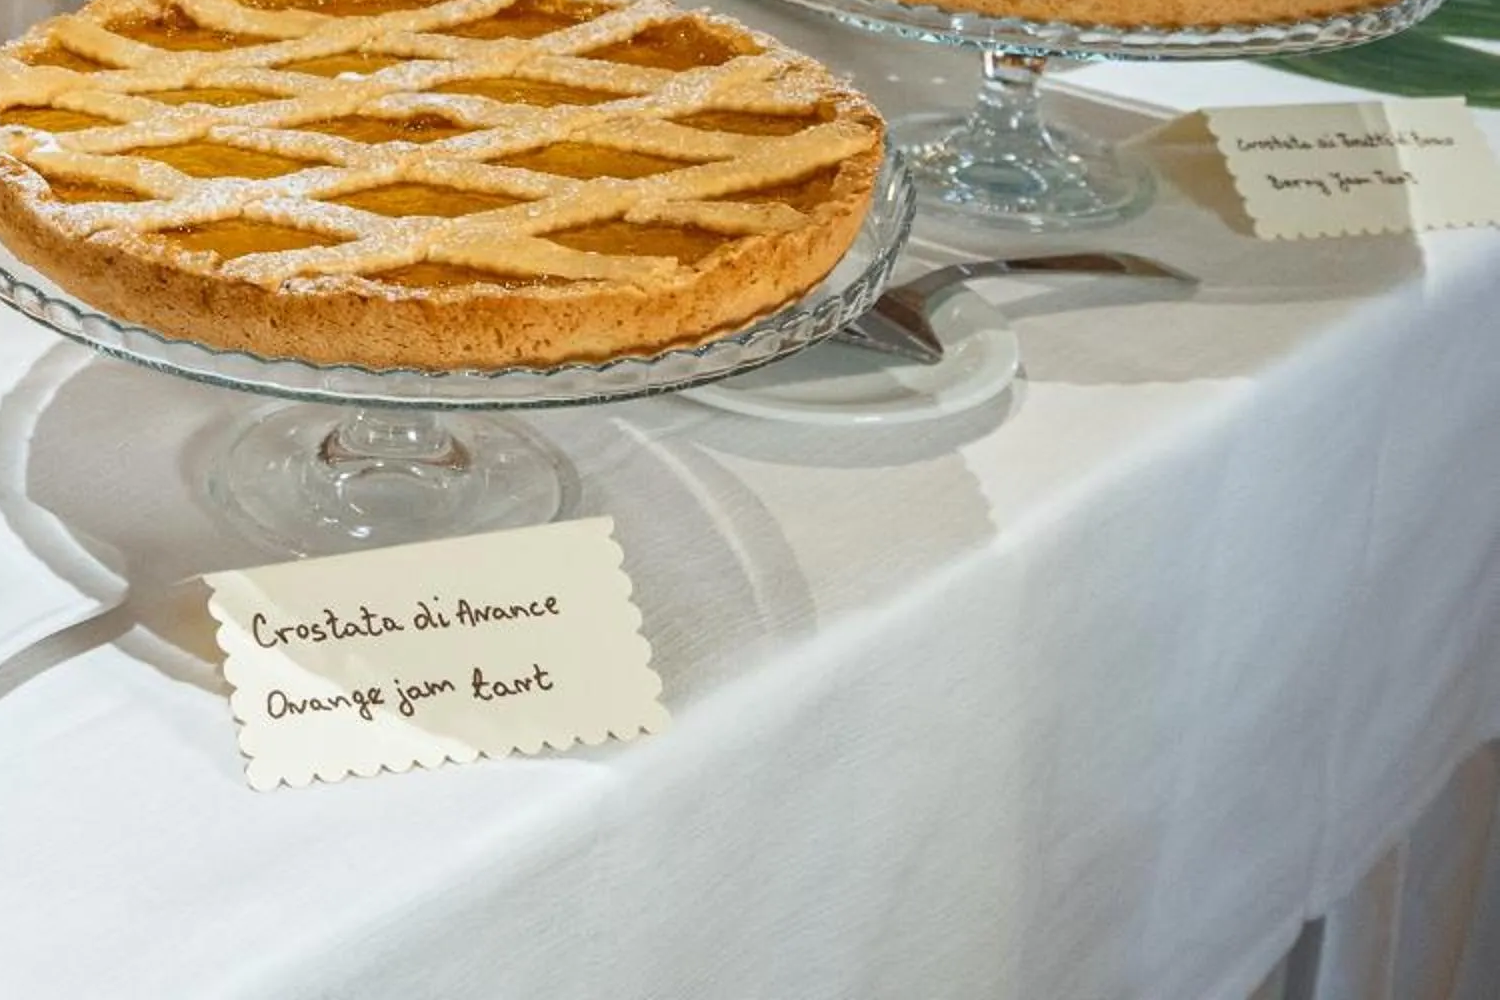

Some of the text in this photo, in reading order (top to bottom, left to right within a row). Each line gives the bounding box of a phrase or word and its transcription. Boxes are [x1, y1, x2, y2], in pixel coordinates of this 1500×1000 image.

[250, 606, 406, 650] Crostata
[412, 594, 452, 632] di
[264, 662, 556, 723] Orange jam tart
